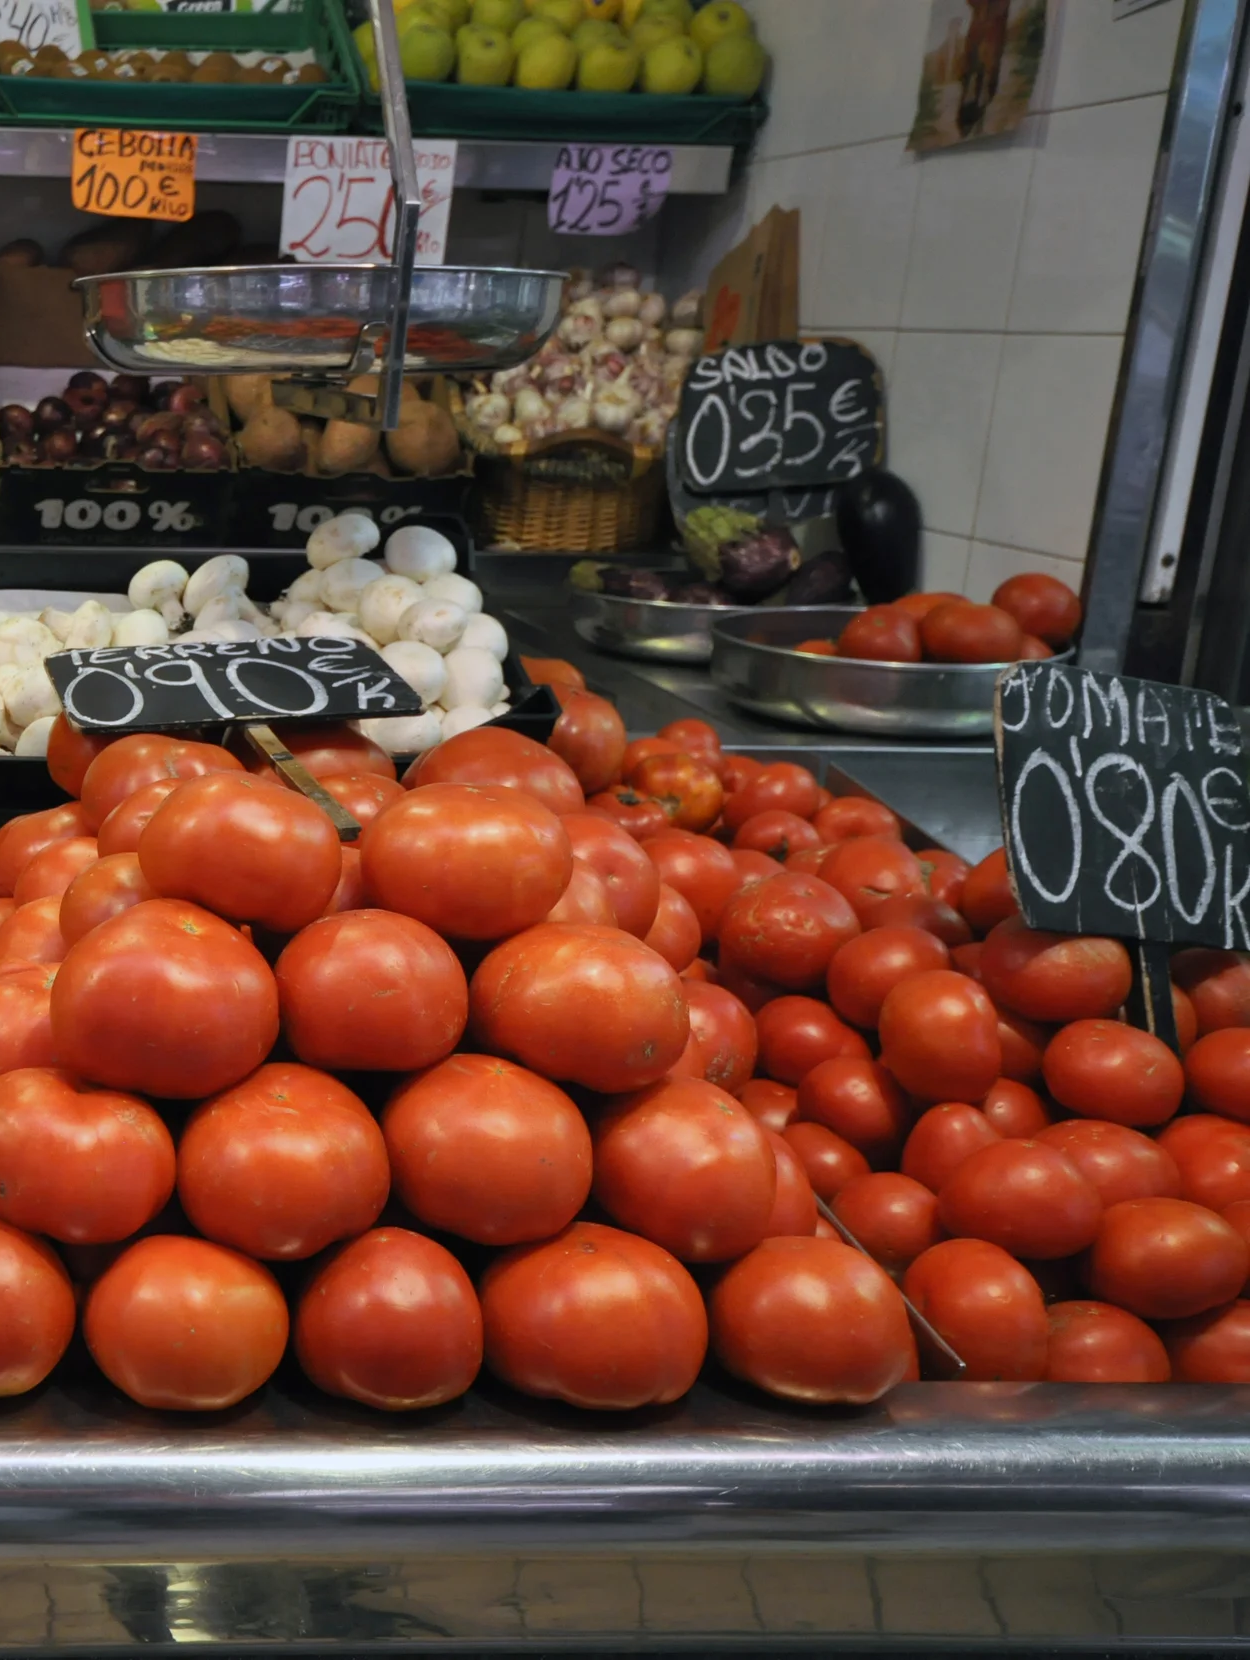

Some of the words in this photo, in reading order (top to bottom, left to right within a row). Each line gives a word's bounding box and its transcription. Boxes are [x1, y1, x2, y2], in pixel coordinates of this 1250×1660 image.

[609, 148, 672, 175] SECO
[159, 176, 180, 196] €
[689, 344, 827, 390] SALDO
[70, 636, 357, 666] TERRENO
[64, 657, 329, 726] 0'90
[1011, 735, 1217, 925] 0'80
